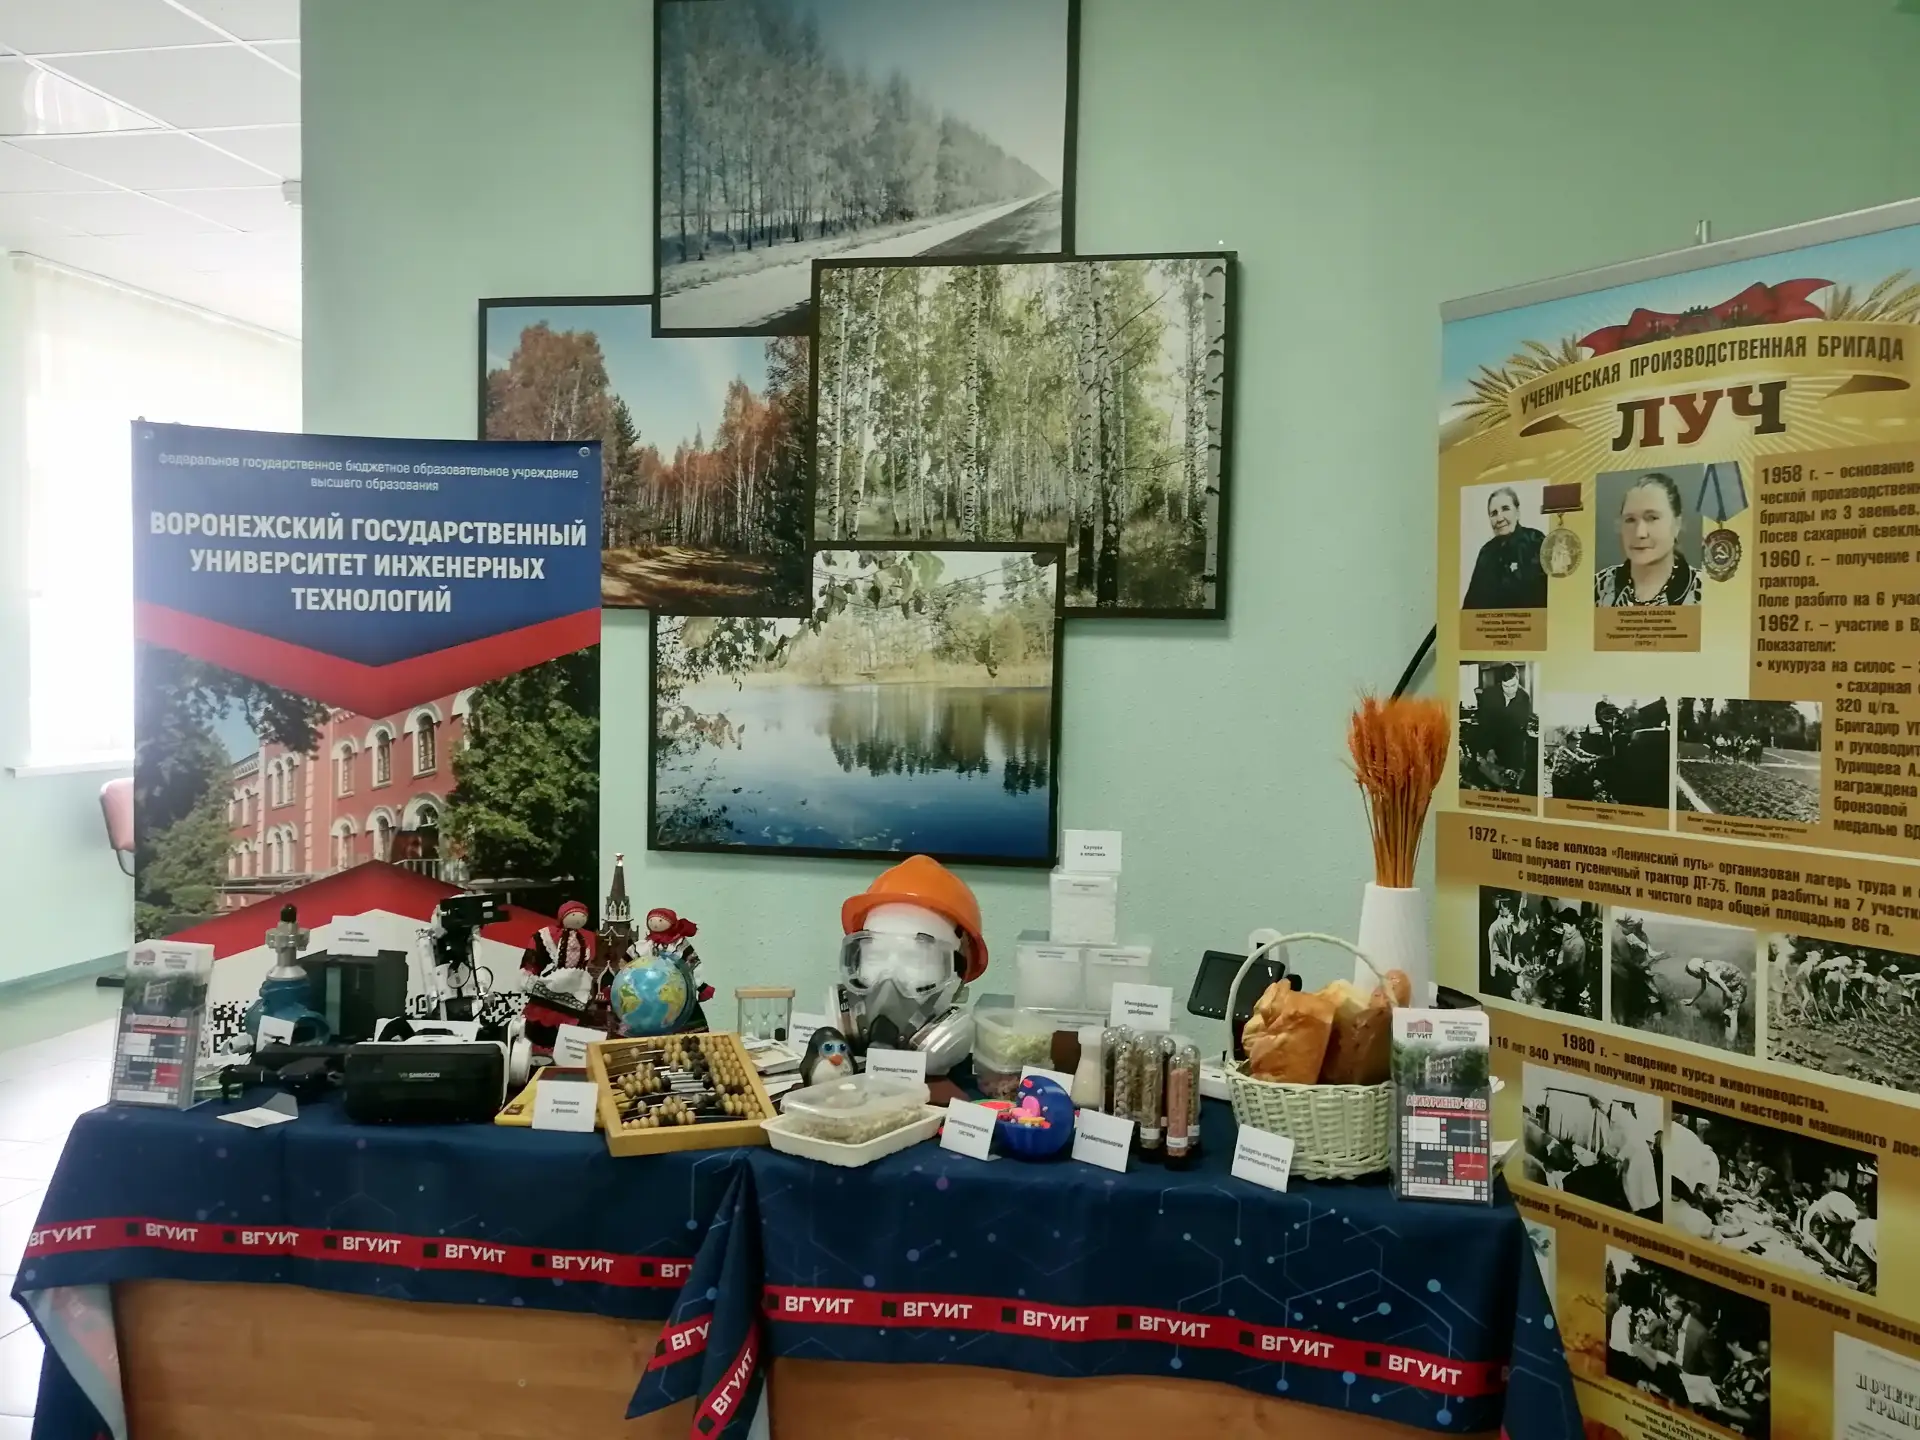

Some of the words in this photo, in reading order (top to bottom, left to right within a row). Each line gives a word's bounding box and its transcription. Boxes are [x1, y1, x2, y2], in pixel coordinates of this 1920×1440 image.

[1521, 362, 1621, 415] УЧЕНИЧЕСКАЯ
[1629, 336, 1807, 380] ПРОИЗВОДСТВЕННАЯ
[1818, 335, 1905, 370] БРИГАДА
[1612, 380, 1788, 452] ЛУЧ
[158, 452, 239, 467] Федеральное
[242, 456, 342, 471] государственное
[345, 459, 409, 474] бюджетное
[413, 464, 508, 479] образовательное
[511, 468, 578, 482] учреждение
[1762, 464, 1802, 484] 1958
[1809, 469, 1818, 481] г.
[1840, 461, 1914, 479] основание
[310, 477, 362, 490] высшего
[365, 478, 439, 492] образования
[1760, 488, 1806, 505] ческой
[1760, 509, 1815, 526] бригады
[1820, 508, 1836, 521] из
[1843, 505, 1852, 520] 3
[1858, 504, 1920, 519] звеньев.
[150, 511, 343, 541] ВОРОНЕЖСКИЙ
[352, 518, 587, 547] ГОСУДАРСТВЕННЫЙ
[1760, 530, 1798, 544] Посев
[1803, 525, 1867, 542] сахарной
[190, 548, 367, 577] УНИВЕРСИТЕТ
[374, 554, 545, 580] ИНЖЕНЕРНЫХ
[1760, 550, 1801, 568] 1960
[1806, 554, 1815, 567] г.
[1836, 551, 1910, 568] получение
[1759, 576, 1820, 590] трактора.
[291, 584, 451, 613] ТЕХНОЛОГИЙ
[1758, 594, 1790, 608] Поле
[1795, 591, 1848, 609] разбито
[1854, 594, 1870, 606] на
[1876, 591, 1885, 606] 6
[1759, 614, 1799, 632] 1962
[1804, 619, 1813, 632] г.
[1835, 619, 1890, 634] участие
[1895, 619, 1904, 632] в
[1757, 638, 1836, 653] Показатели:
[1767, 660, 1826, 674] кукуруза
[1832, 660, 1848, 672] на
[1854, 659, 1896, 673] силос
[1847, 681, 1911, 696] сахарная
[1836, 698, 1861, 714] 320
[1867, 700, 1900, 716] ц/га.
[1835, 718, 1900, 737] Бригадир
[1835, 740, 1844, 752] и
[1835, 757, 1901, 777] Турищева
[1834, 778, 1918, 799] награждена
[1834, 796, 1908, 817] бронзовой
[1833, 819, 1898, 838] медалью
[1468, 826, 1497, 844] 1972
[1534, 836, 1560, 853] базе
[1562, 841, 1607, 858] колхоза
[1718, 860, 1801, 885] организован
[1804, 870, 1852, 892] лагерь
[1857, 878, 1898, 898] труда
[1902, 884, 1912, 897] и
[1491, 848, 1524, 865] Школа
[1575, 858, 1641, 880] гусеничный
[1644, 871, 1689, 889] трактор
[1693, 874, 1730, 895] ДТ-75.
[1734, 880, 1766, 900] Поля
[1771, 886, 1829, 909] разбиты
[1833, 896, 1850, 912] на
[1856, 897, 1864, 912] 7
[1587, 881, 1632, 899] озимых
[1636, 884, 1644, 898] и
[1647, 885, 1691, 906] чистого
[1696, 894, 1726, 912] пара
[1728, 899, 1773, 919] общей
[1775, 907, 1847, 931] площадью
[1851, 916, 1870, 934] 86
[1874, 921, 1894, 938] га.
[1562, 1031, 1596, 1056] 1980
[1624, 1050, 1678, 1076] введение
[1682, 1065, 1717, 1086] курса
[1720, 1076, 1829, 1114] животноводства.
[1529, 1045, 1549, 1061] 840
[1552, 1050, 1591, 1073] учениц
[1594, 1062, 1646, 1088] получили
[1649, 1076, 1736, 1110] удостоверения
[1740, 1100, 1804, 1128] мастеров
[1808, 1117, 1888, 1150] машинного
[145, 1223, 199, 1243] ВГУИТ
[241, 1231, 300, 1247] ВГУИТ
[342, 1236, 402, 1256] ВГУИТ
[445, 1243, 507, 1264] ВГУИТ
[554, 1255, 615, 1275] ВГУИТ
[784, 1294, 855, 1315] ВГУИТ
[903, 1301, 974, 1320] ВГУИТ
[1022, 1309, 1091, 1333] ВГУИТ
[1138, 1315, 1211, 1339] ВГУИТ
[1260, 1333, 1336, 1360] ВГУИТ
[1388, 1354, 1464, 1386] ВГУИТ
[711, 1347, 753, 1416] ВГУИТ
